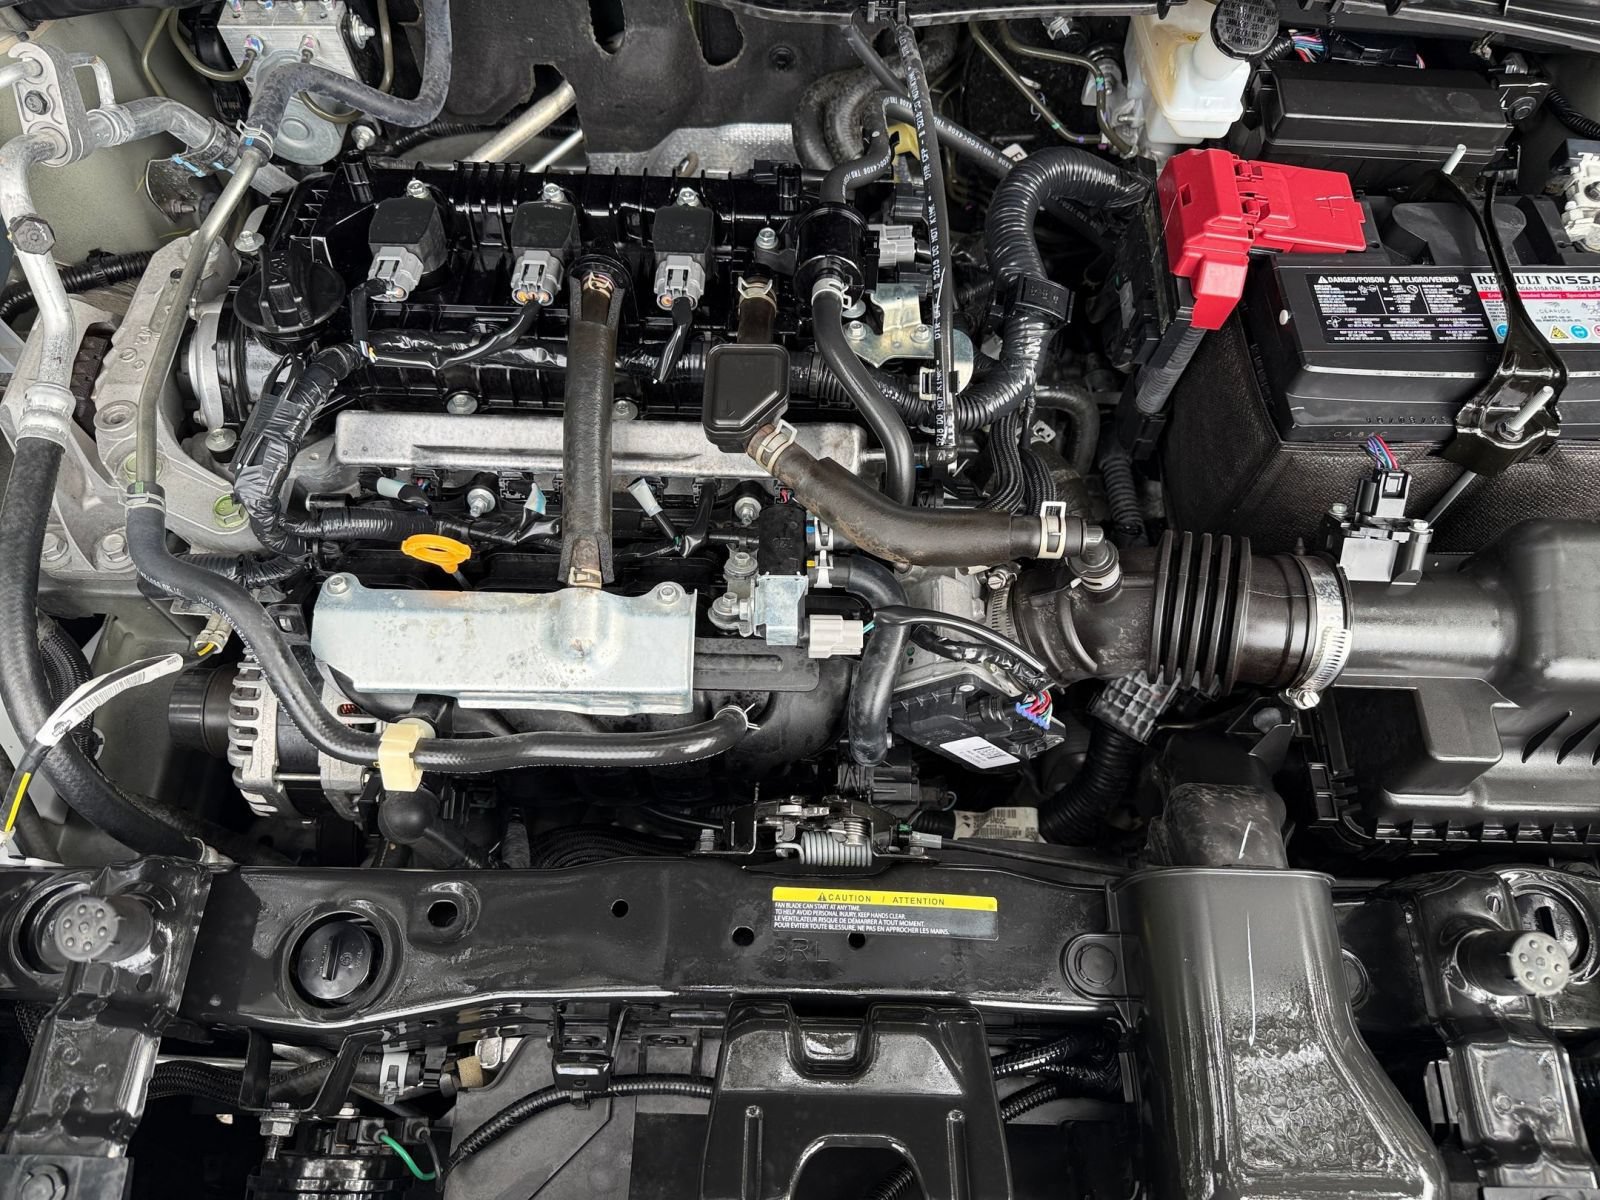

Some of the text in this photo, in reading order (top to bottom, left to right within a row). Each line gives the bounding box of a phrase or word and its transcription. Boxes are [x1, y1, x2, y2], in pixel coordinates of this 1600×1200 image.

[1477, 275, 1541, 285] REULT
[936, 395, 945, 411] NOT
[936, 414, 944, 425] DO
[828, 894, 872, 902] CAUTION
[892, 896, 945, 905] ATTENTION
